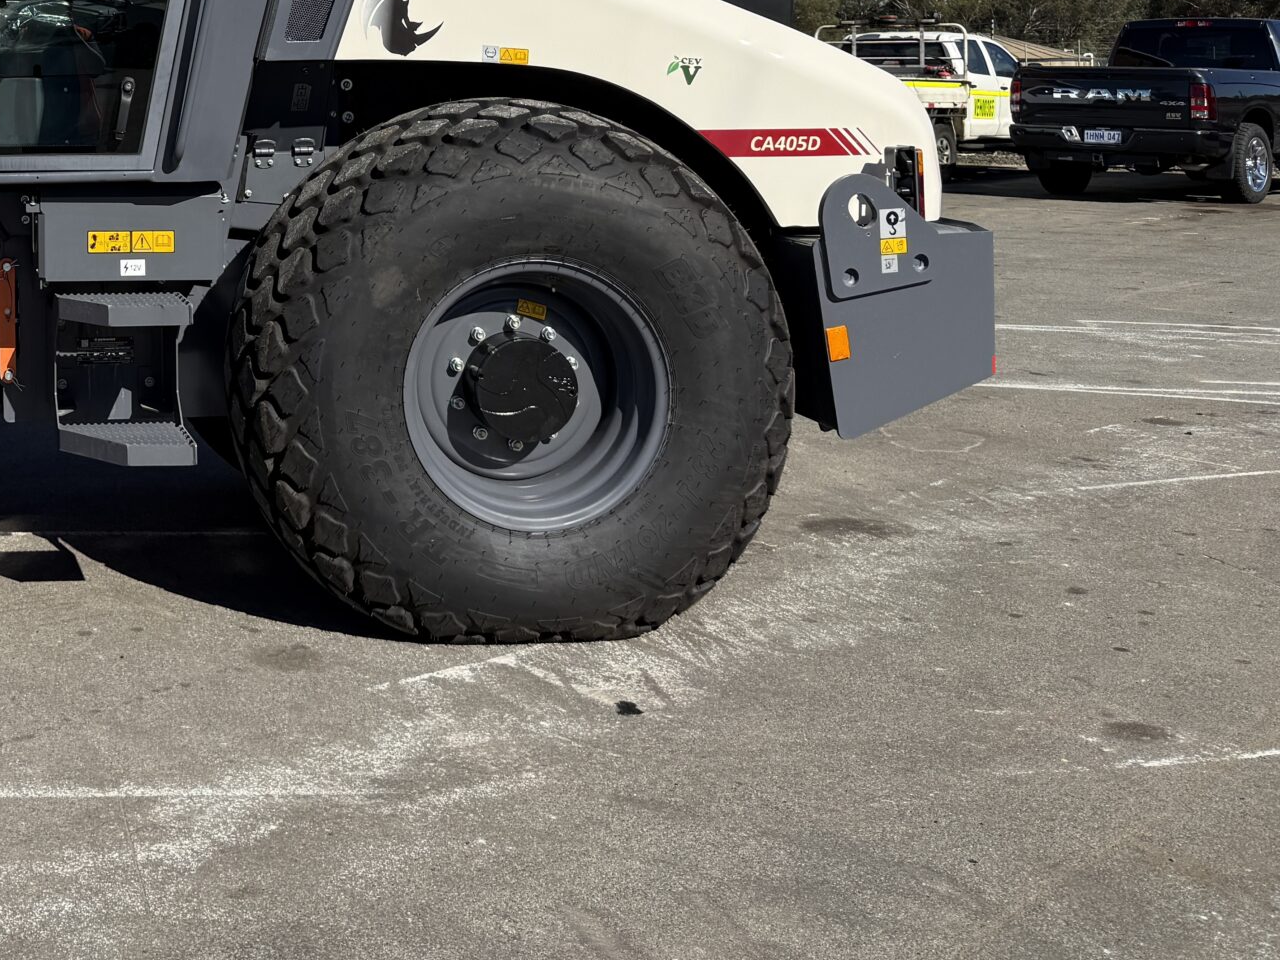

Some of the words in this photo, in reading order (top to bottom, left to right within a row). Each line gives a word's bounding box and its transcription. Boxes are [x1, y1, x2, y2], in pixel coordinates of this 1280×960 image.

[681, 57, 702, 65] CEV
[680, 65, 702, 86] V
[1053, 87, 1152, 102] RAM
[750, 135, 822, 152] CA405D
[129, 264, 142, 272] 12V
